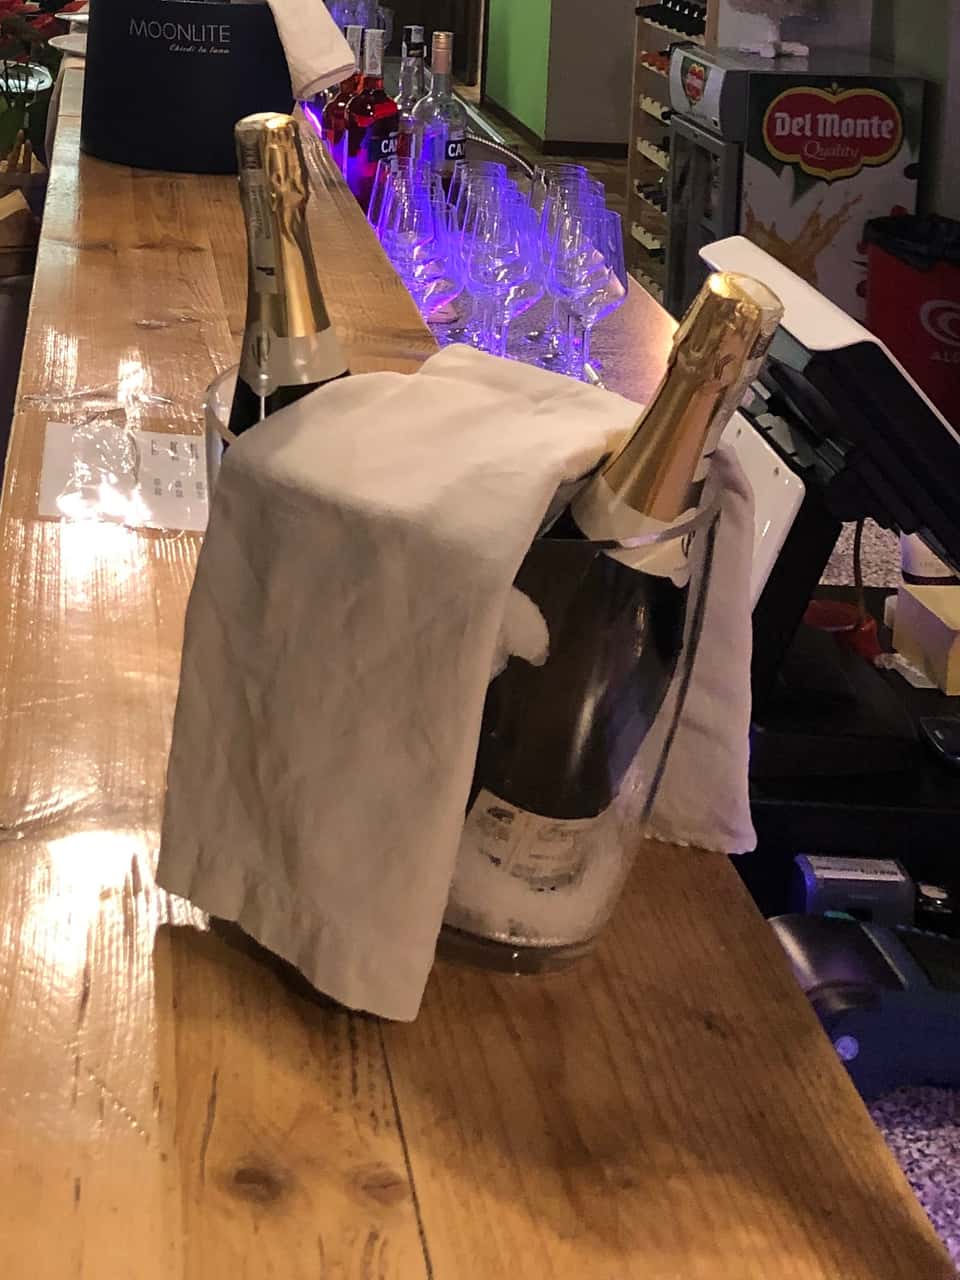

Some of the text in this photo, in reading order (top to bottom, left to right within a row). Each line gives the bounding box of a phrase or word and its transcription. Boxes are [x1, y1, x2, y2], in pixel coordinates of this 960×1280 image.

[129, 18, 231, 43] MOONLITE
[774, 112, 895, 139] Del Monte
[804, 140, 860, 160] Quality
